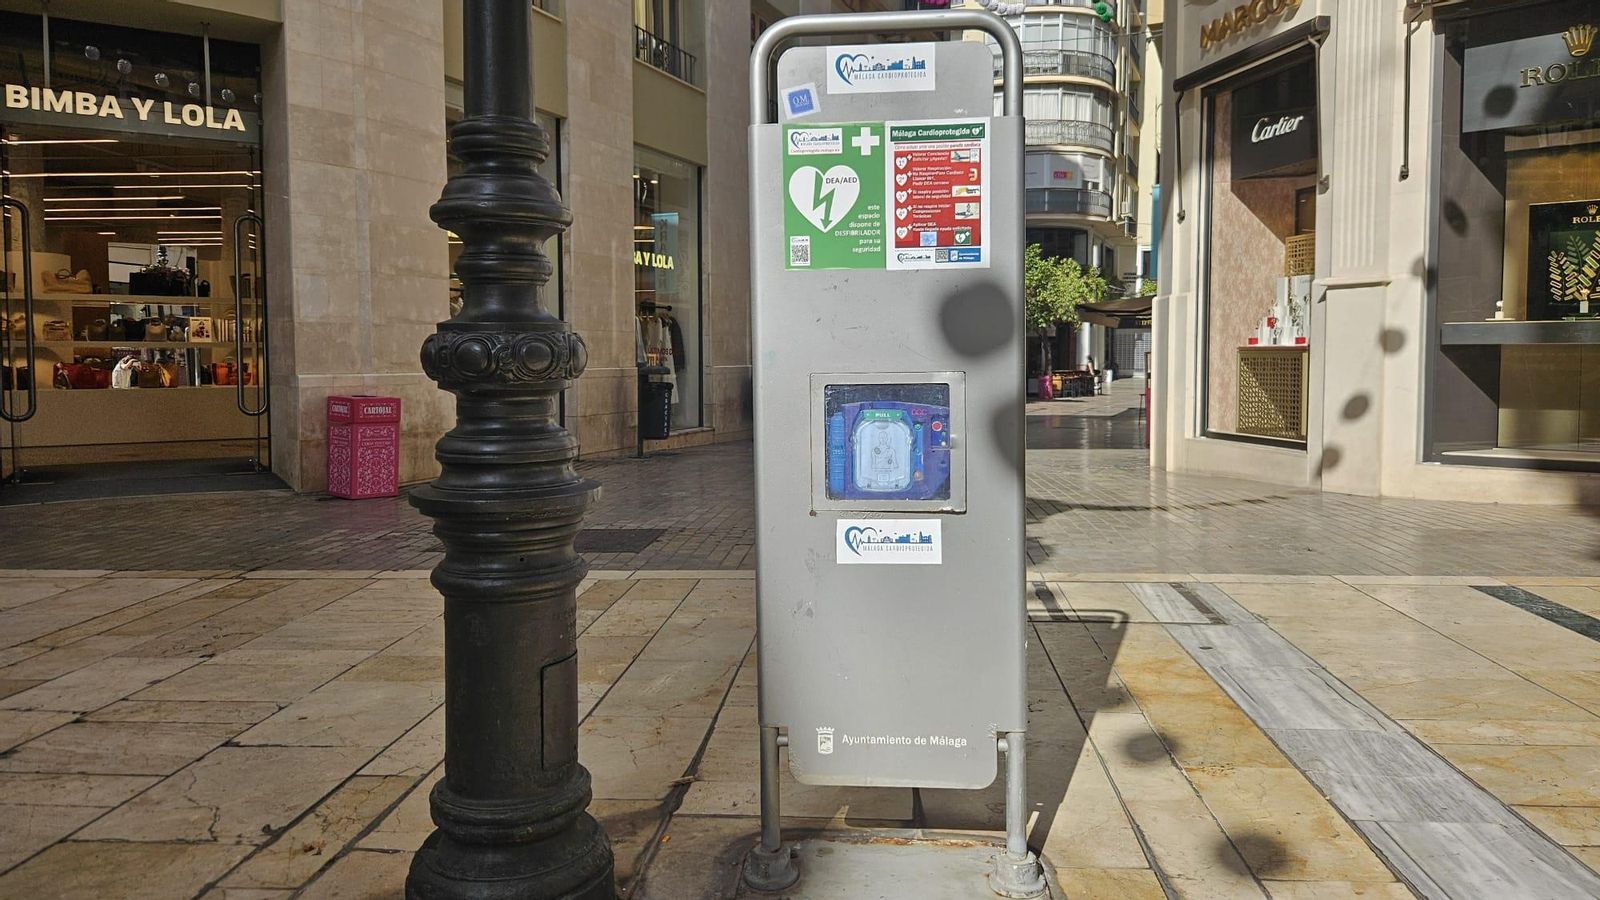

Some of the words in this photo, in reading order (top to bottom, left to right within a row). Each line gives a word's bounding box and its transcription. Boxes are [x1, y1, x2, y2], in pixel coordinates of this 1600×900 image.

[854, 71, 876, 80] MÁLAGA
[877, 71, 927, 79] CARDIOPROTEGIDA
[5, 83, 124, 119] BIMBA
[131, 97, 155, 121] Y
[163, 101, 246, 131] LOLA
[892, 130, 916, 138] Málaga
[917, 127, 970, 137] Cardioprotegida
[1251, 115, 1304, 143] Cartier
[825, 176, 858, 185] DEA/AED
[834, 229, 880, 237] DESFIBRILADOR
[643, 251, 651, 266] Y
[651, 253, 675, 270] LOLA
[842, 733, 912, 746] Ayuntamiento
[914, 735, 927, 745] de
[930, 735, 968, 748] Málaga
